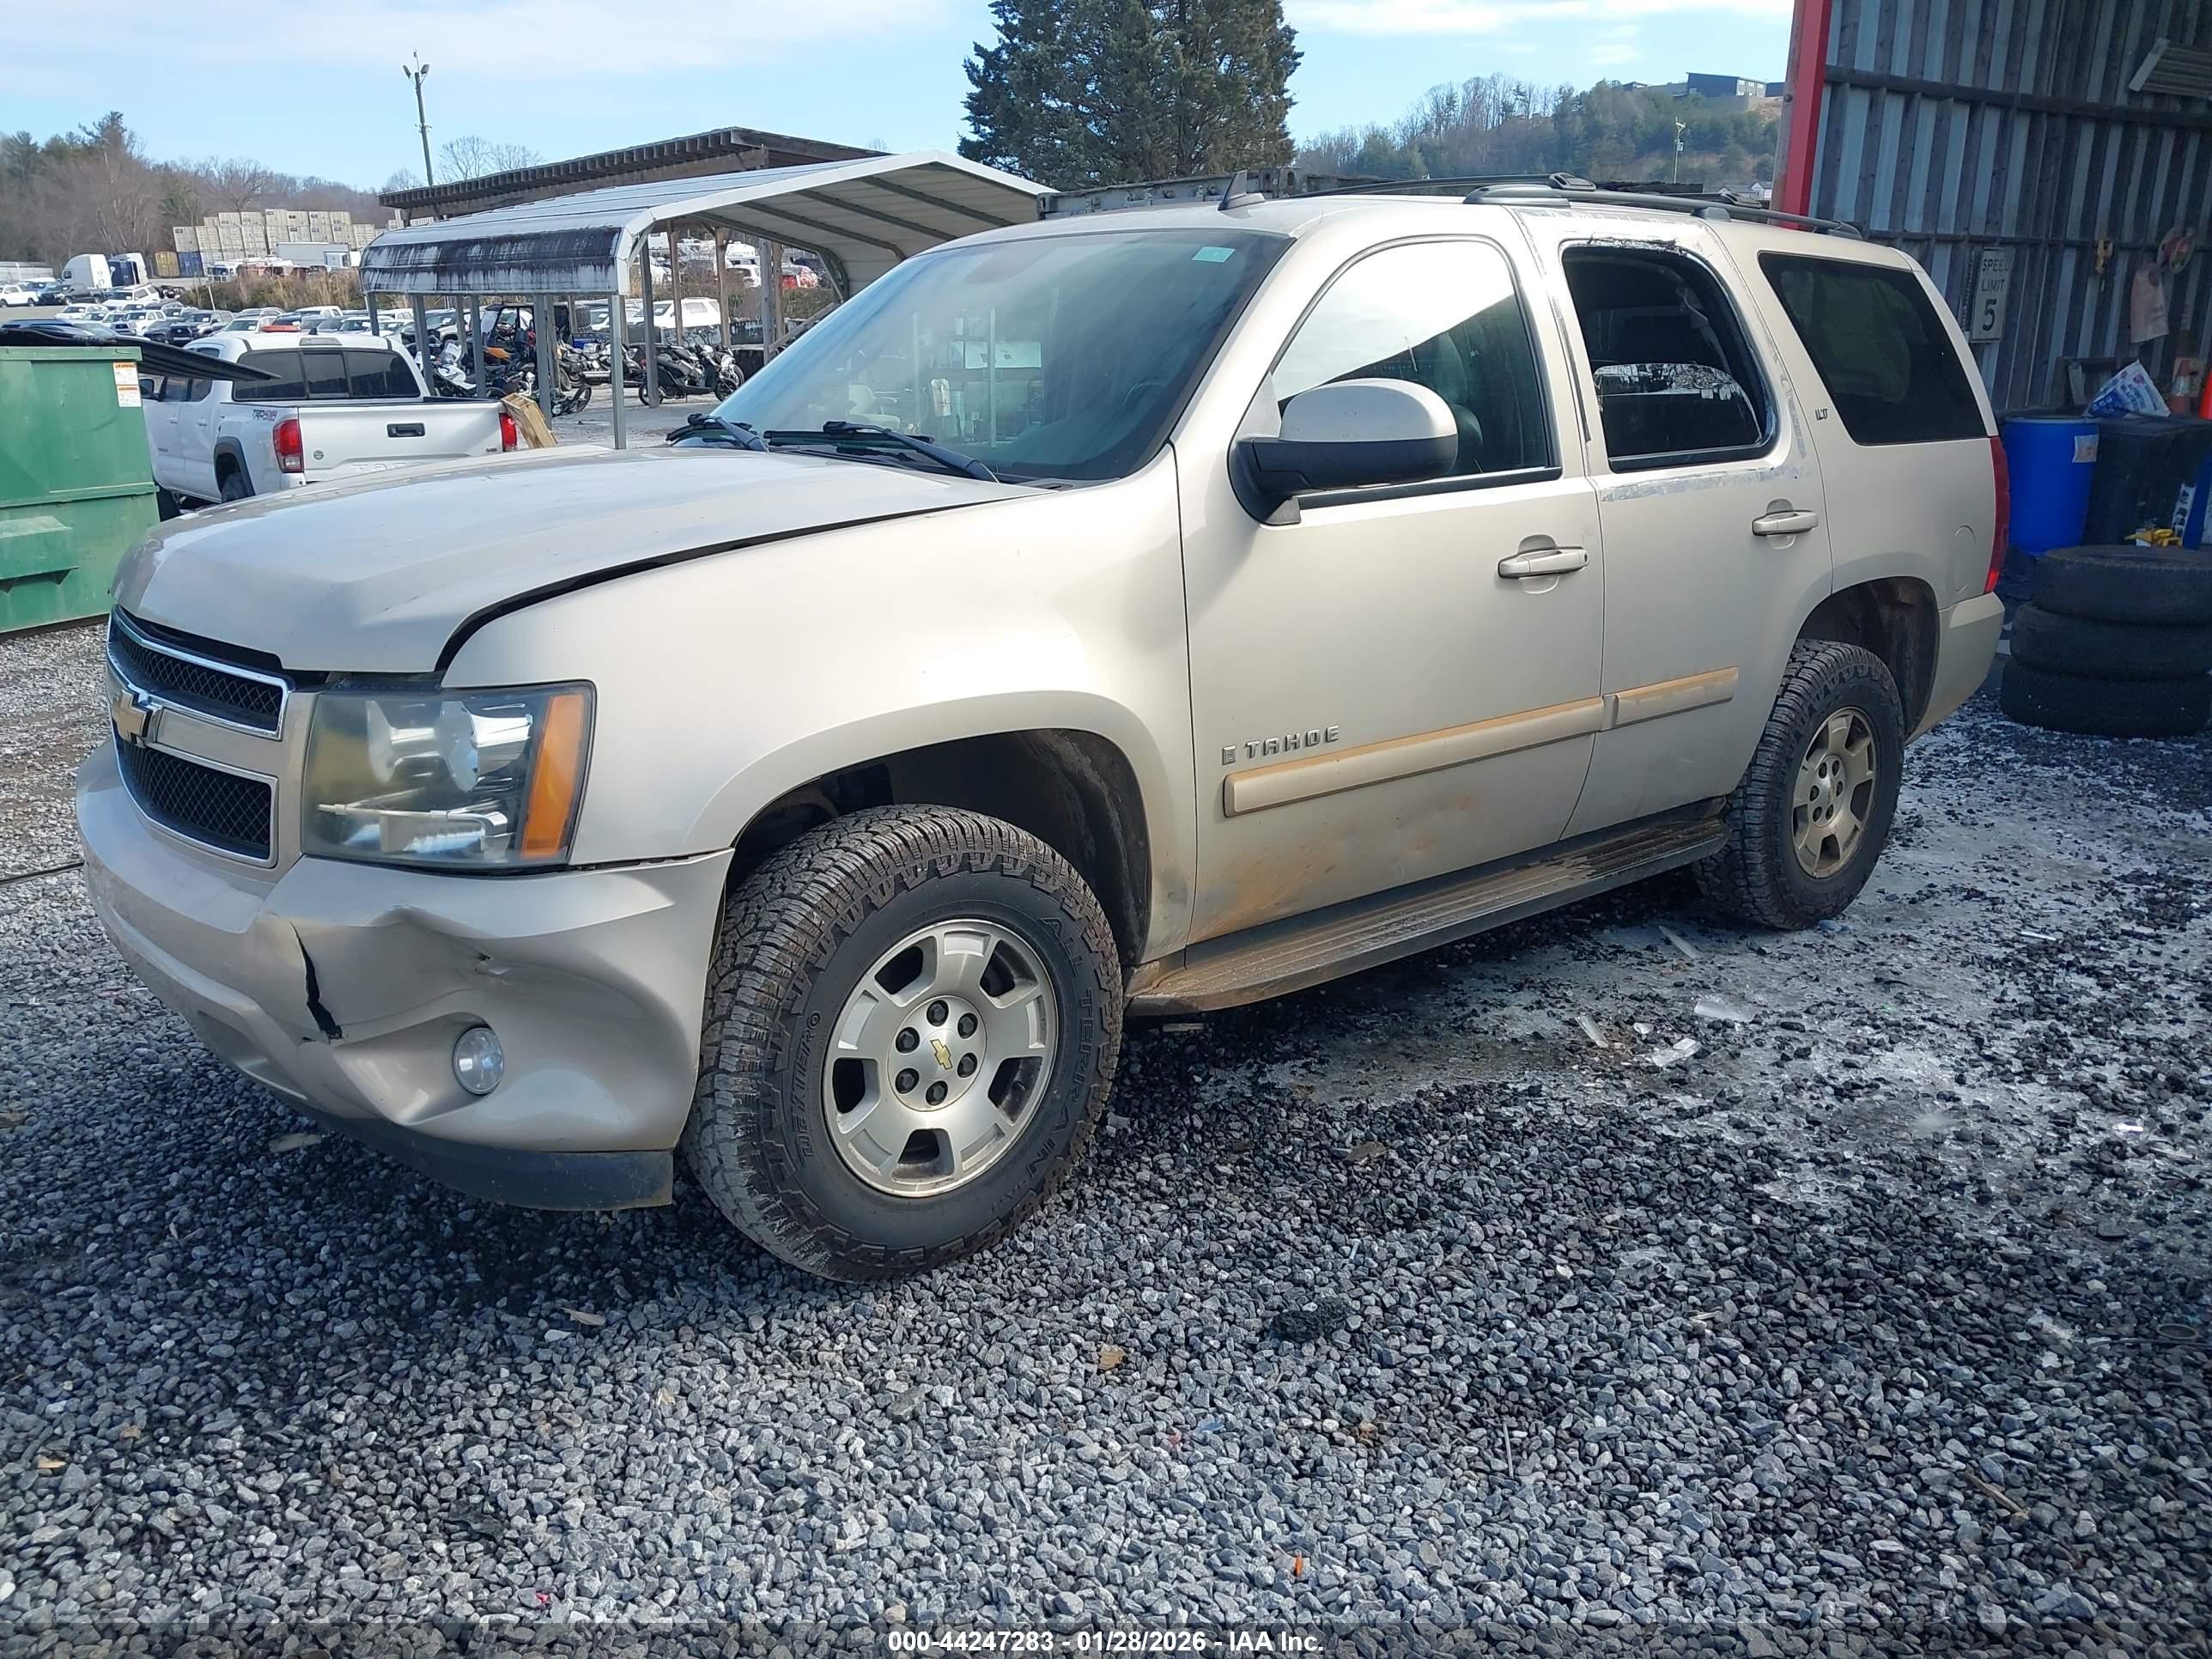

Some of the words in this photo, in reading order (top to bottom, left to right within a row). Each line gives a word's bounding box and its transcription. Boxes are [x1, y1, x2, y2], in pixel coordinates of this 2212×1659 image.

[1981, 279, 2005, 291] LIMIT
[1982, 298, 1997, 331] 5
[1244, 725, 1340, 759] TAHOE
[1039, 916, 1085, 976] ALL
[792, 1010, 822, 1166] DEXTERO
[1027, 988, 1094, 1178] TERRAIN
